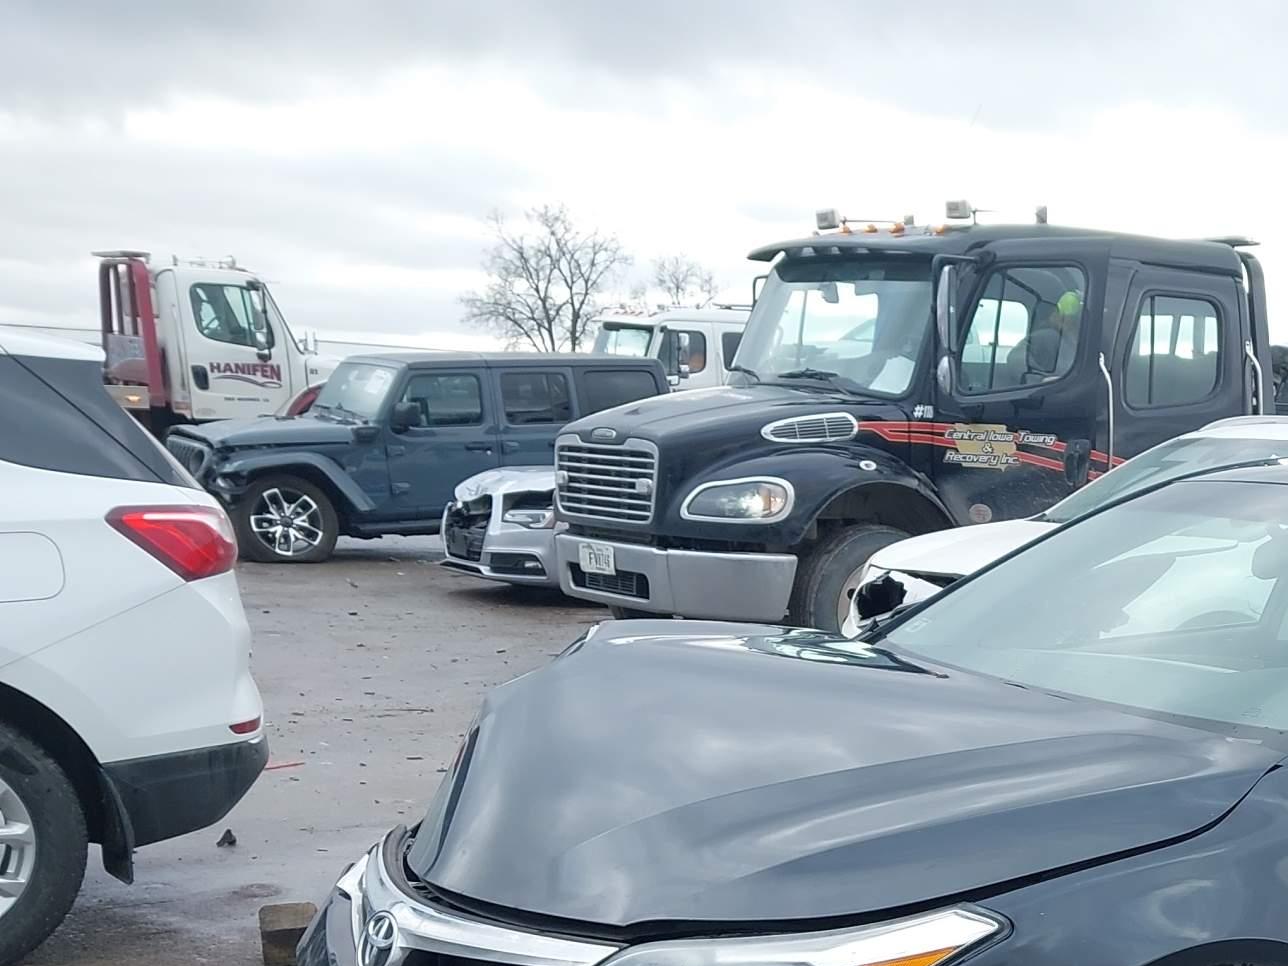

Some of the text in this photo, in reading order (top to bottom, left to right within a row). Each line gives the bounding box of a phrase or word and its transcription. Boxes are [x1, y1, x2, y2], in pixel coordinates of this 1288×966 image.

[209, 362, 282, 382] HANIFEN
[944, 429, 1057, 445] Central Iowa Towing
[982, 442, 993, 454] &
[944, 452, 1021, 465] Recovery Inc.
